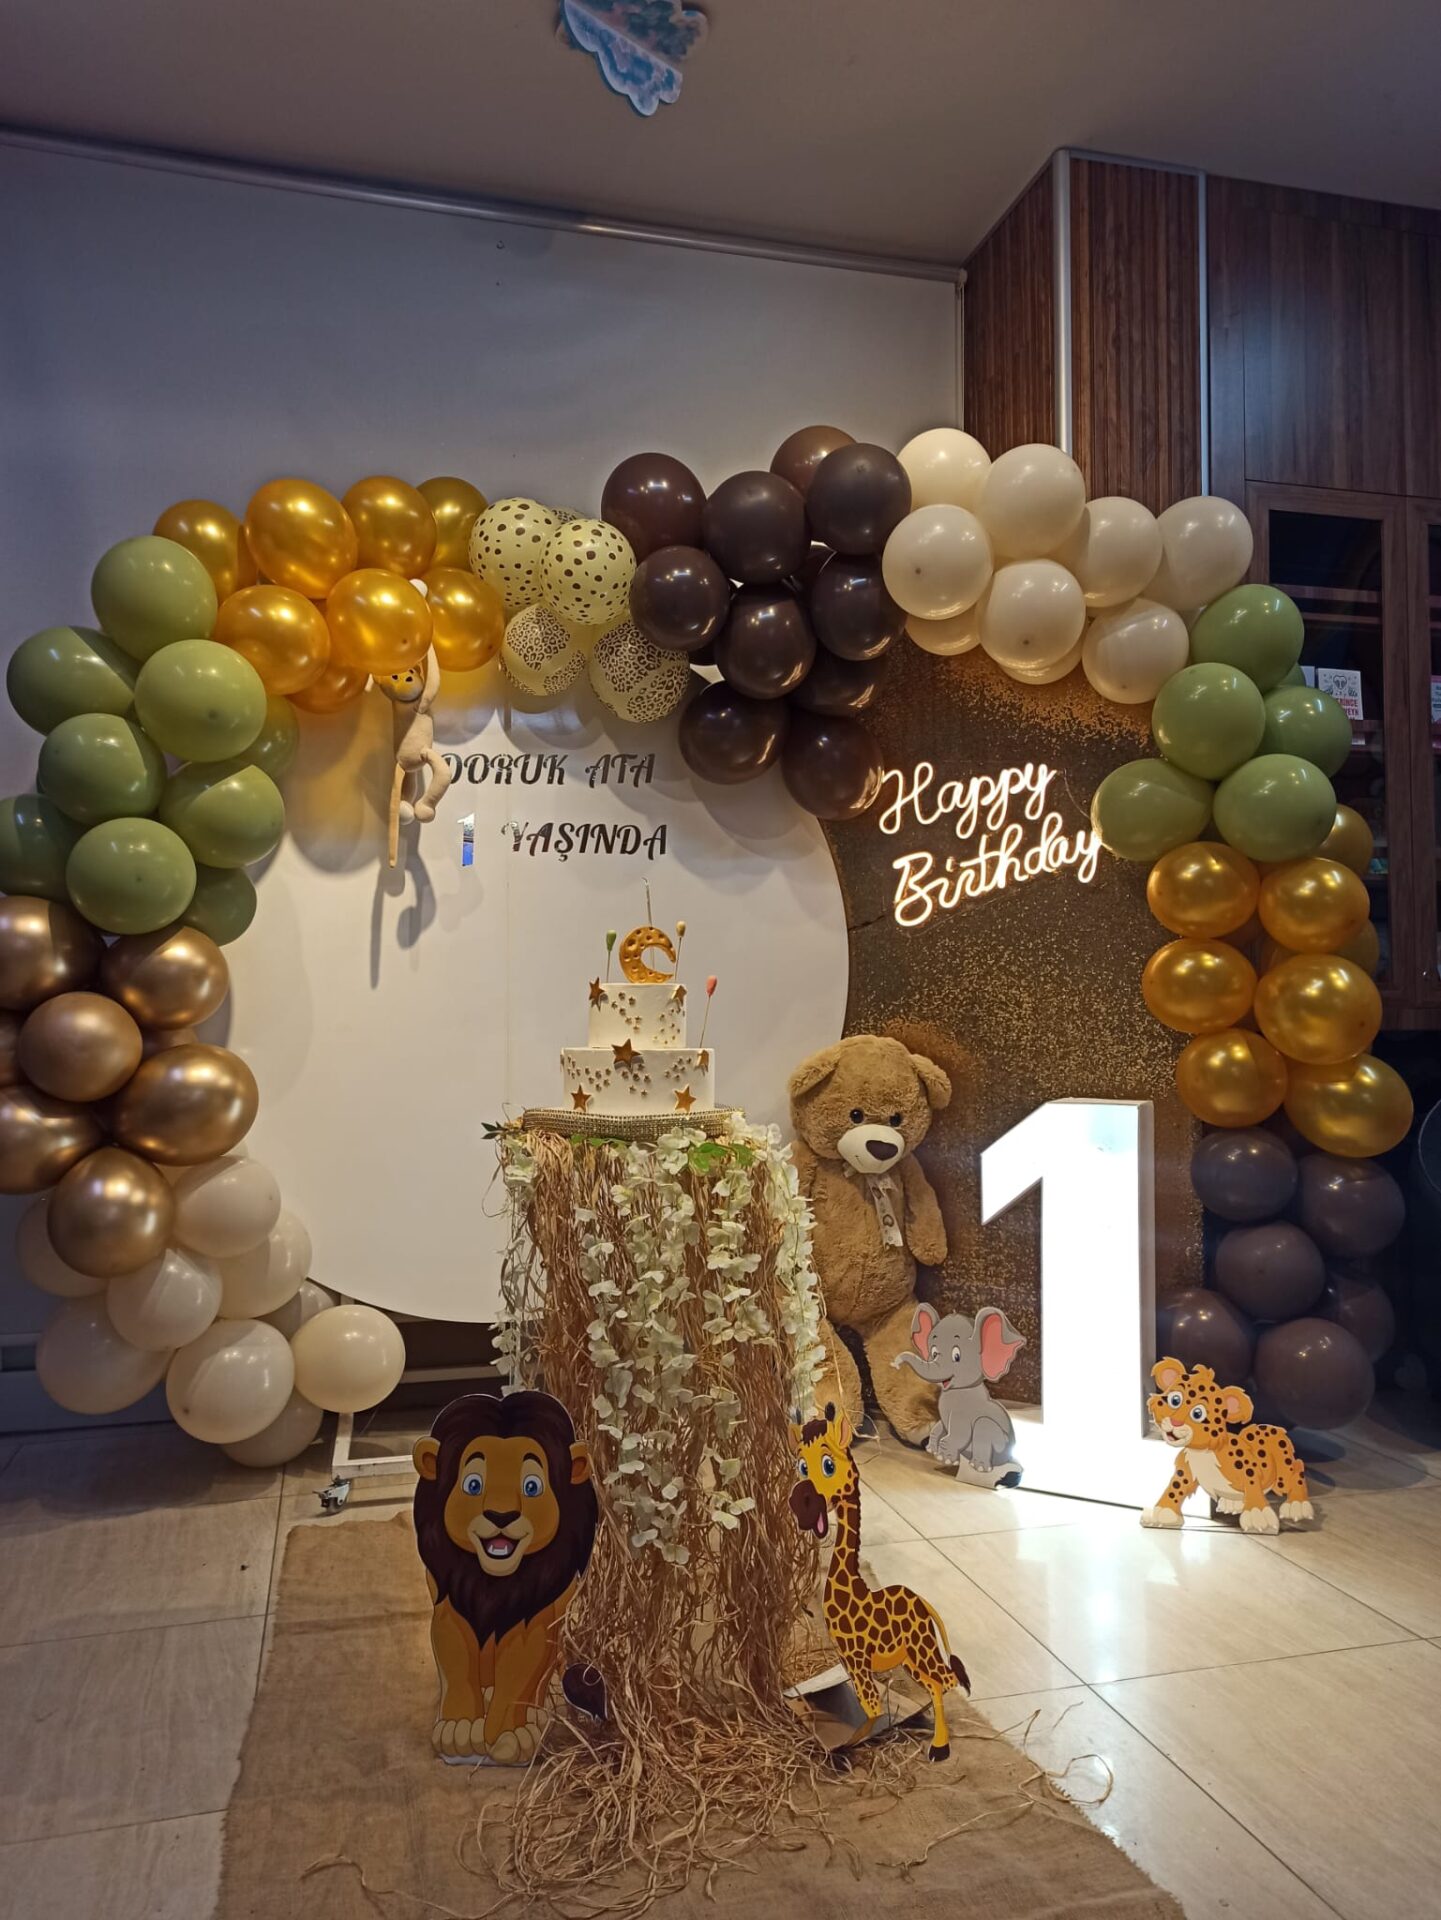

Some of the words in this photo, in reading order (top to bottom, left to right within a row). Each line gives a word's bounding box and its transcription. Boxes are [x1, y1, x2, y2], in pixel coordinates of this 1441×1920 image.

[442, 753, 568, 785] DORUK
[585, 753, 655, 788] ATA
[879, 762, 1057, 839] Happy
[457, 813, 475, 867] 1
[501, 821, 667, 862] YAŞINDA
[893, 812, 1102, 926] Birthday
[980, 1097, 1211, 1518] 1
